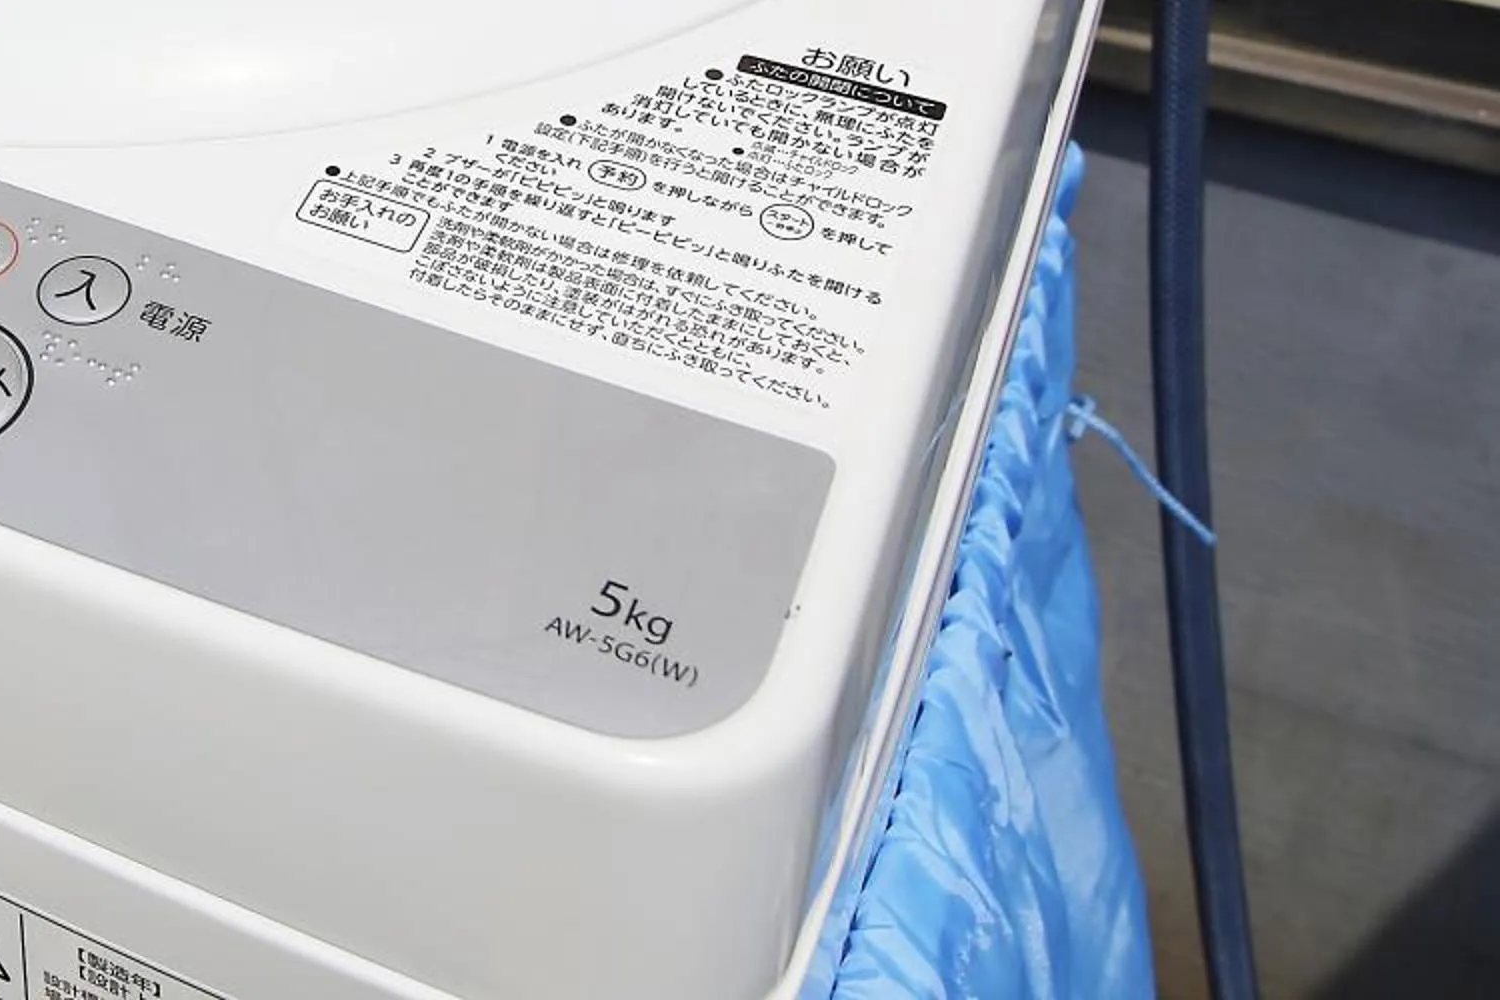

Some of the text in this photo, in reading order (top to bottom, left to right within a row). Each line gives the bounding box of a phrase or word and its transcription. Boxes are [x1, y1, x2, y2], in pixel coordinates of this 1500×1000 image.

[751, 61, 936, 115] ふたの開閉について
[802, 47, 911, 88] お願い
[601, 102, 683, 133] あります。
[656, 85, 931, 165] 開けないでください。ランプが
[683, 76, 936, 151] しているときに、無理にふたを
[726, 72, 940, 138] ふたロックランプが点灯
[631, 93, 927, 179] 消灯していても開かない場合が
[496, 152, 558, 176] ください
[502, 138, 582, 170] 電源を入れ
[598, 163, 639, 187] 予約
[652, 181, 753, 217] を押しながら
[319, 188, 417, 228] お手入れの
[401, 174, 514, 213] ことができます
[309, 201, 369, 231] お願い
[820, 226, 894, 255] を押して
[55, 270, 97, 311] 入
[139, 301, 212, 344] 電源
[590, 579, 673, 645] 5kg
[544, 616, 699, 688] AW-5G6(W)
